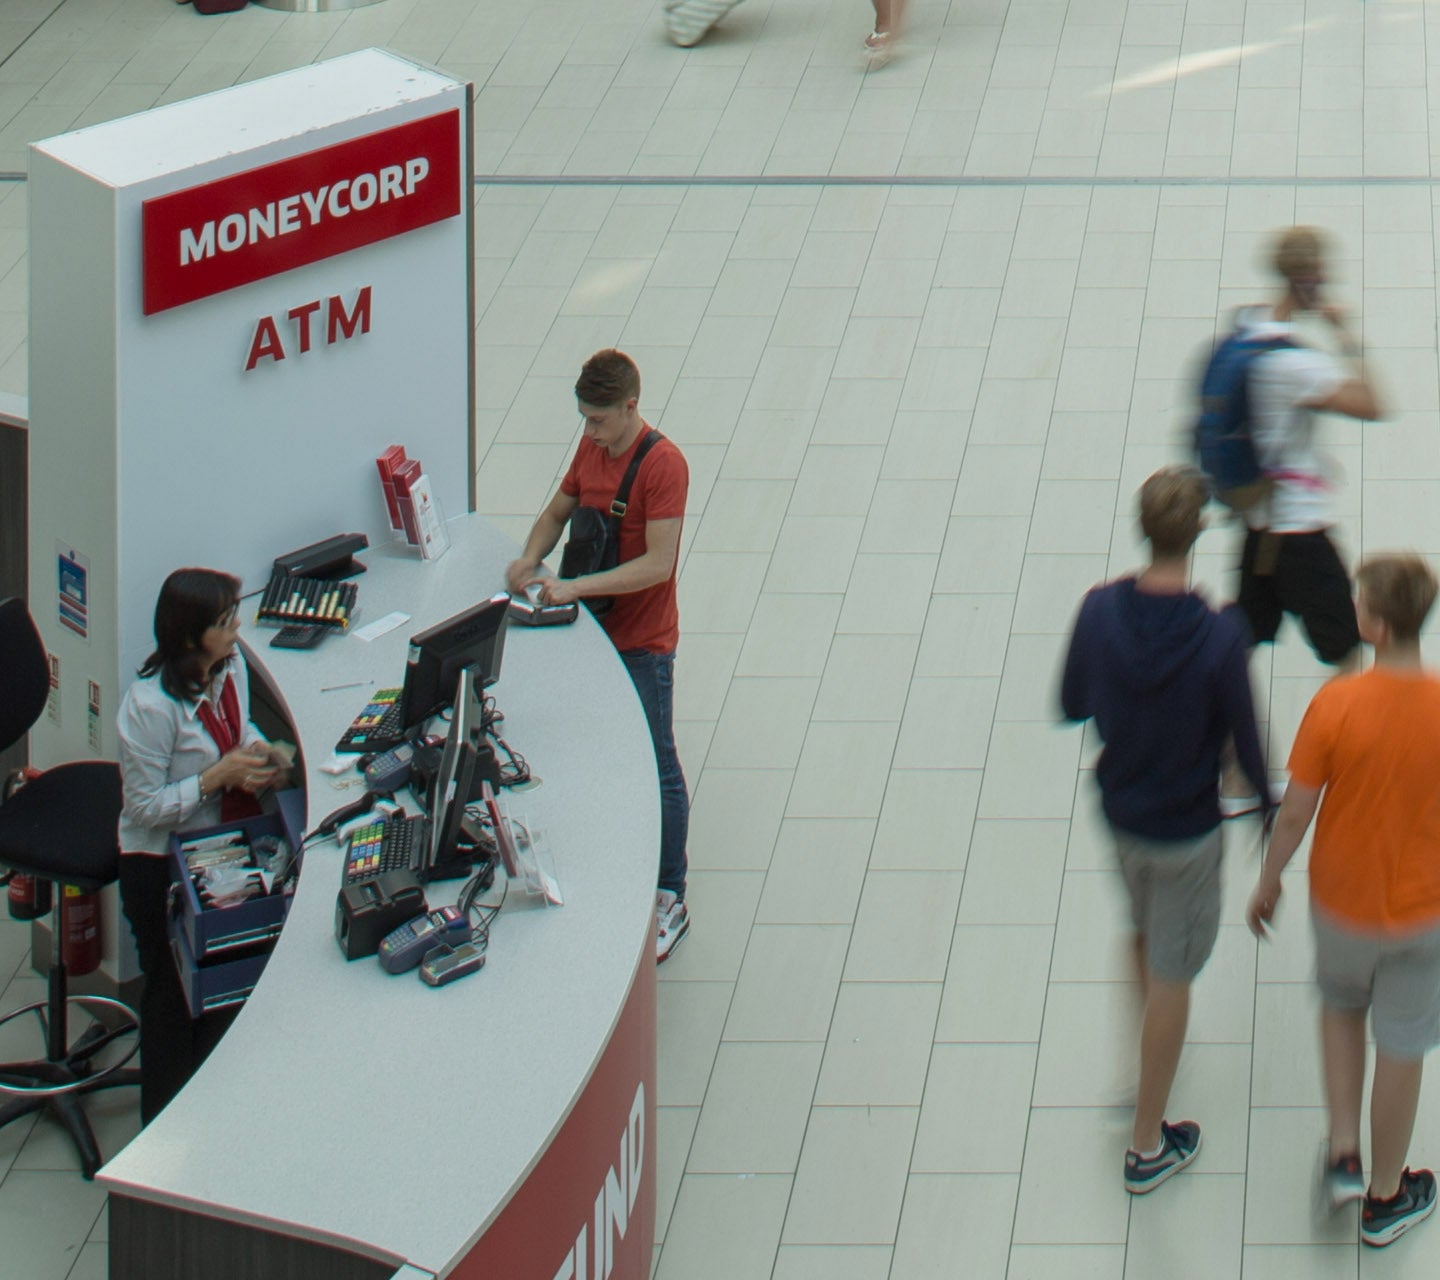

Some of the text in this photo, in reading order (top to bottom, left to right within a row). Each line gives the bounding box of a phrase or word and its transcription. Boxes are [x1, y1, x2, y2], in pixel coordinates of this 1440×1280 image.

[179, 155, 431, 267] MONEYCORP
[244, 284, 375, 373] ATM
[553, 1080, 645, 1280] UND
